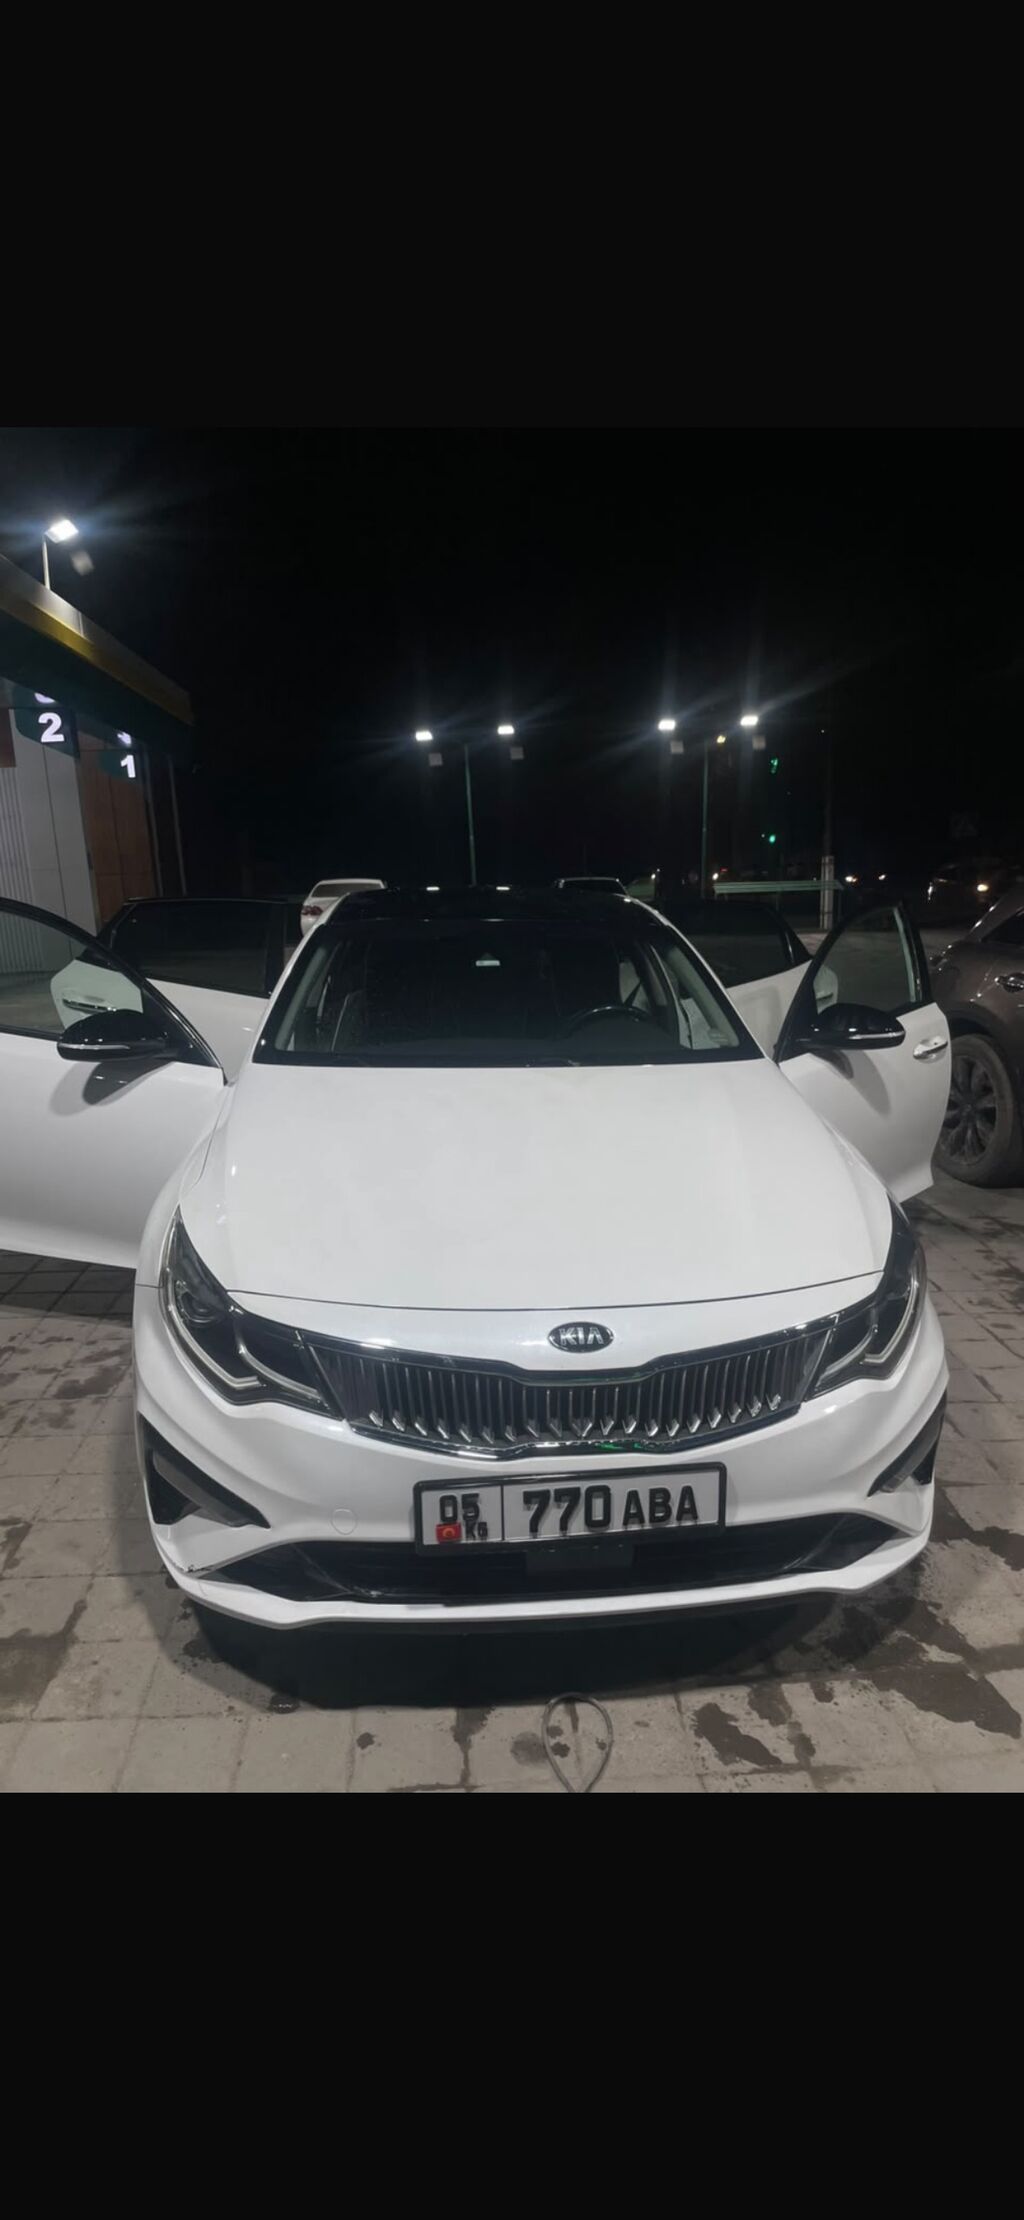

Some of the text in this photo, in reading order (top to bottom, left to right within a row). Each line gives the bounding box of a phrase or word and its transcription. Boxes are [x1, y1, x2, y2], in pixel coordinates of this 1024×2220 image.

[38, 712, 65, 743] 2
[120, 755, 136, 778] 1
[559, 1326, 604, 1346] KIA
[439, 1493, 480, 1523] 05
[522, 1485, 699, 1537] 770 ABA
